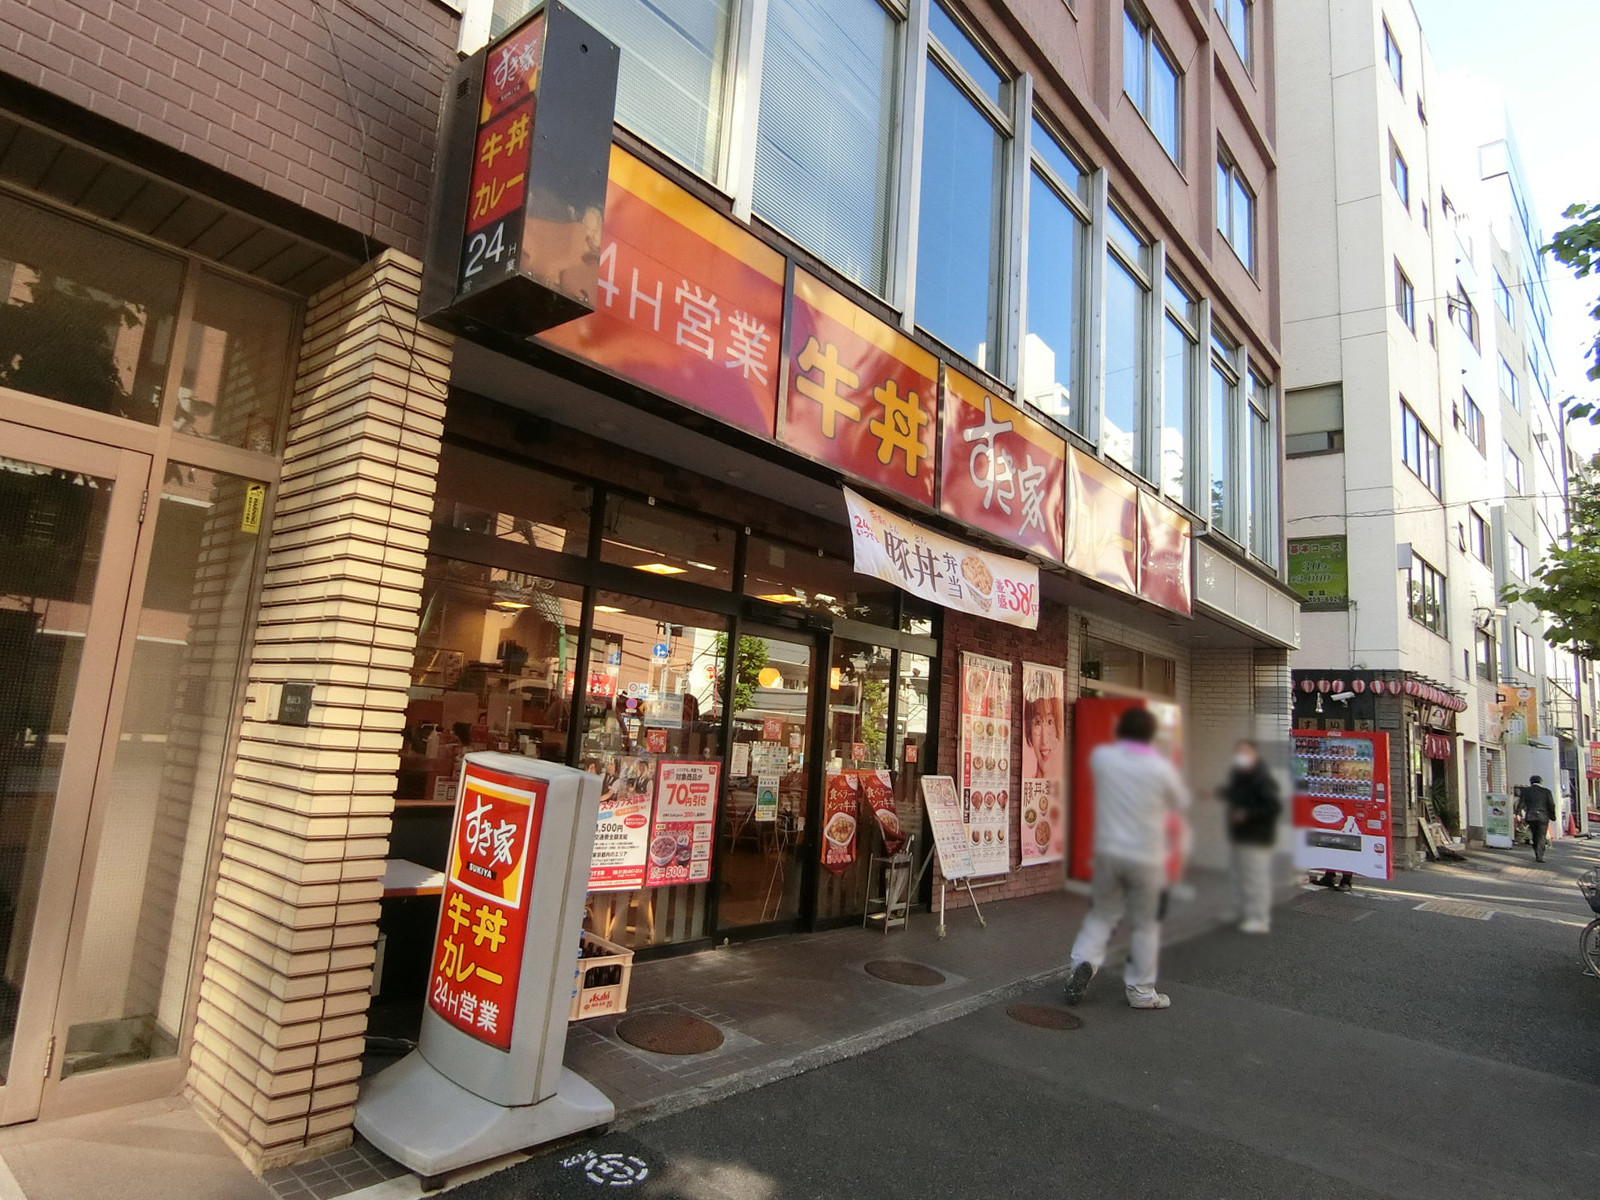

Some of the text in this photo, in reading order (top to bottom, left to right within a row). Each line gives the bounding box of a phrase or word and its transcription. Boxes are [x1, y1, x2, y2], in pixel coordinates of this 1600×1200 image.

[493, 38, 538, 90] すき家
[480, 112, 530, 169] 牛丼
[473, 171, 525, 221] カレー
[796, 334, 929, 478] 牛丼
[963, 395, 1047, 536] すき家
[884, 529, 944, 593] 豚丼
[942, 552, 963, 600] 弁当
[666, 783, 708, 807] 70円引き
[465, 794, 518, 868] すき家
[468, 862, 493, 880] SUKIYA
[447, 892, 508, 953] 牛丼
[439, 934, 503, 985] カレー
[433, 975, 500, 1034] 24H営業
